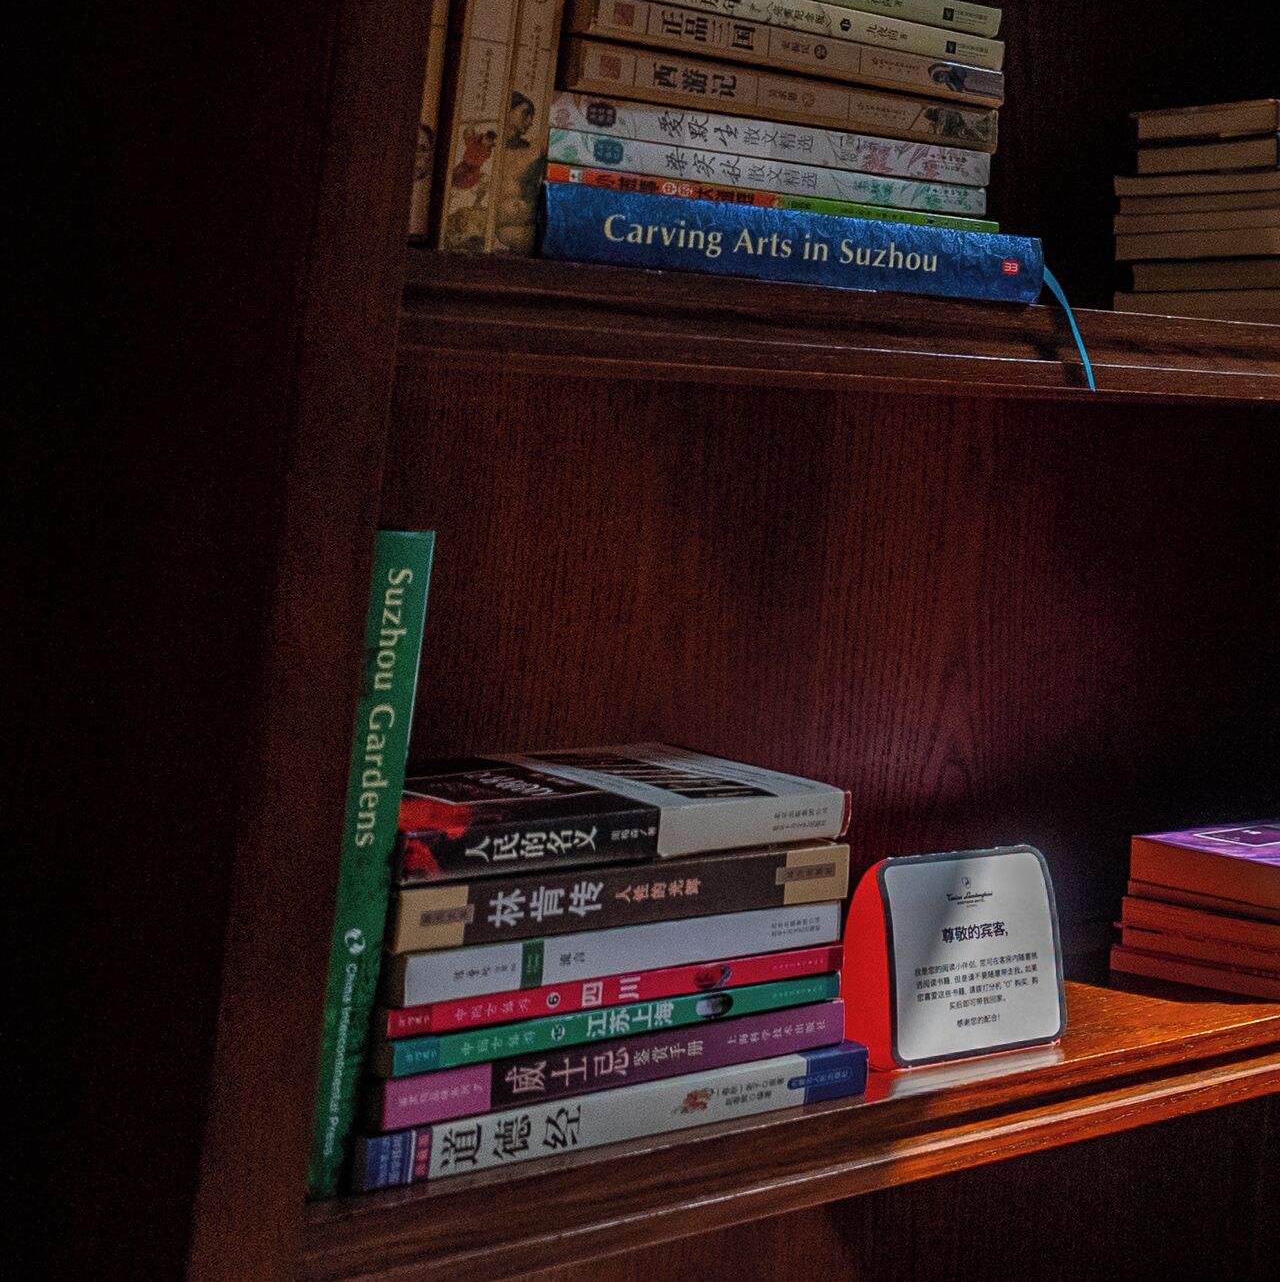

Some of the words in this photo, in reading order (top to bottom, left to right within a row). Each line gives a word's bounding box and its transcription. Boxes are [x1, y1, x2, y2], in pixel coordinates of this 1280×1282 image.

[660, 9, 756, 51] 正品三国
[653, 62, 738, 99] 西游记
[603, 213, 724, 258] Carving
[732, 227, 793, 259] Arts
[802, 233, 830, 262] in
[838, 238, 939, 273] Suzhou
[371, 567, 413, 690] Suzhou
[354, 703, 396, 848] Gardens
[464, 823, 596, 865] 人民的名义
[487, 878, 604, 929] 林肯传
[341, 962, 356, 1001] China
[581, 975, 641, 1008] 四川
[586, 999, 674, 1039] 江苏上海
[726, 1017, 826, 1047] 上海科学技术出版社
[505, 1038, 703, 1096] 威士忌鉴赏手册
[439, 1102, 582, 1171] 道德经
